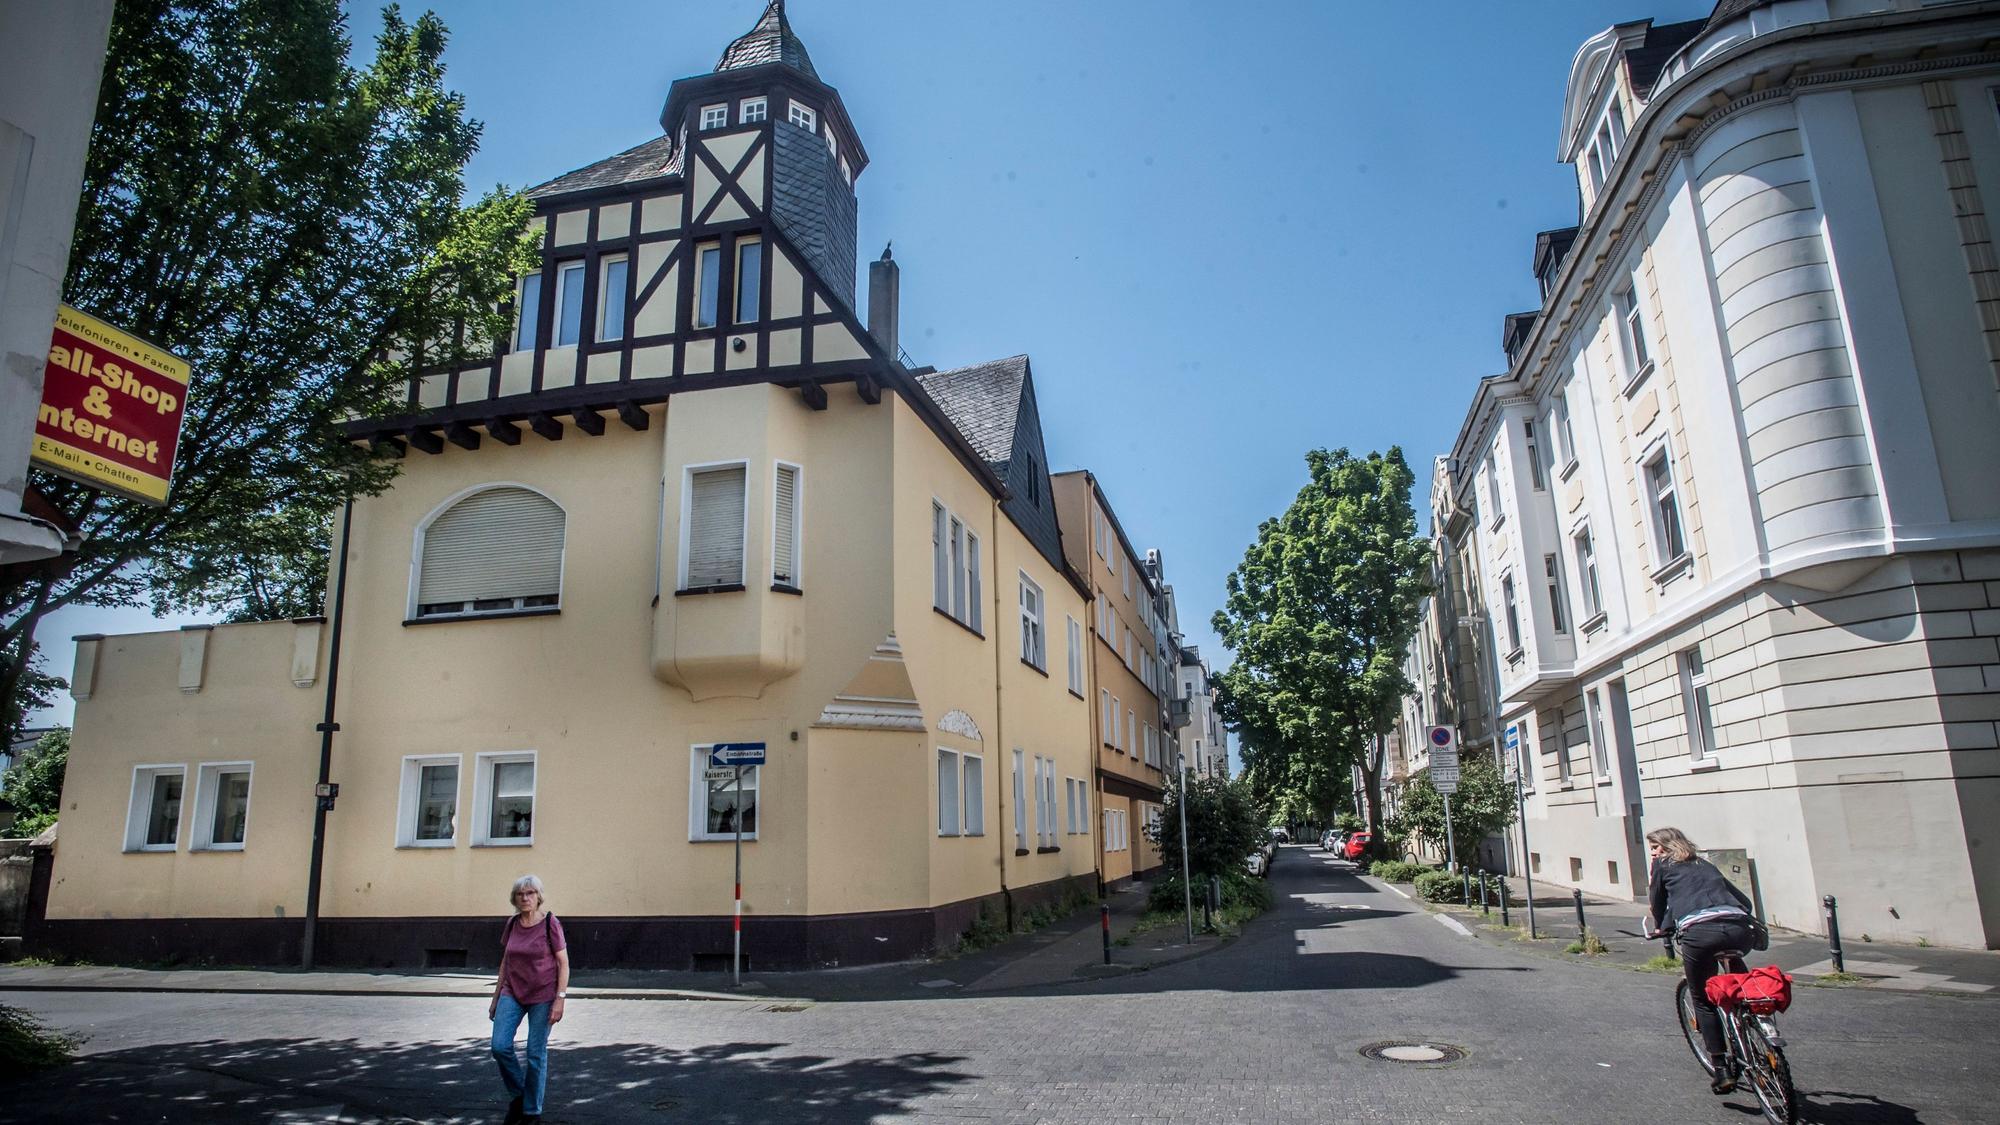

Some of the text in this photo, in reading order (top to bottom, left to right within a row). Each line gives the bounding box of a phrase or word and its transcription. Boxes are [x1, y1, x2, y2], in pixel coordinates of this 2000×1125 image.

[56, 313, 176, 375] Telefonieren Faxen
[48, 345, 177, 415] all-Shop
[82, 385, 112, 420] &
[38, 403, 159, 464] nternet
[40, 442, 139, 485] E-Mail Chatten
[704, 770, 733, 779] Kaiserstr.
